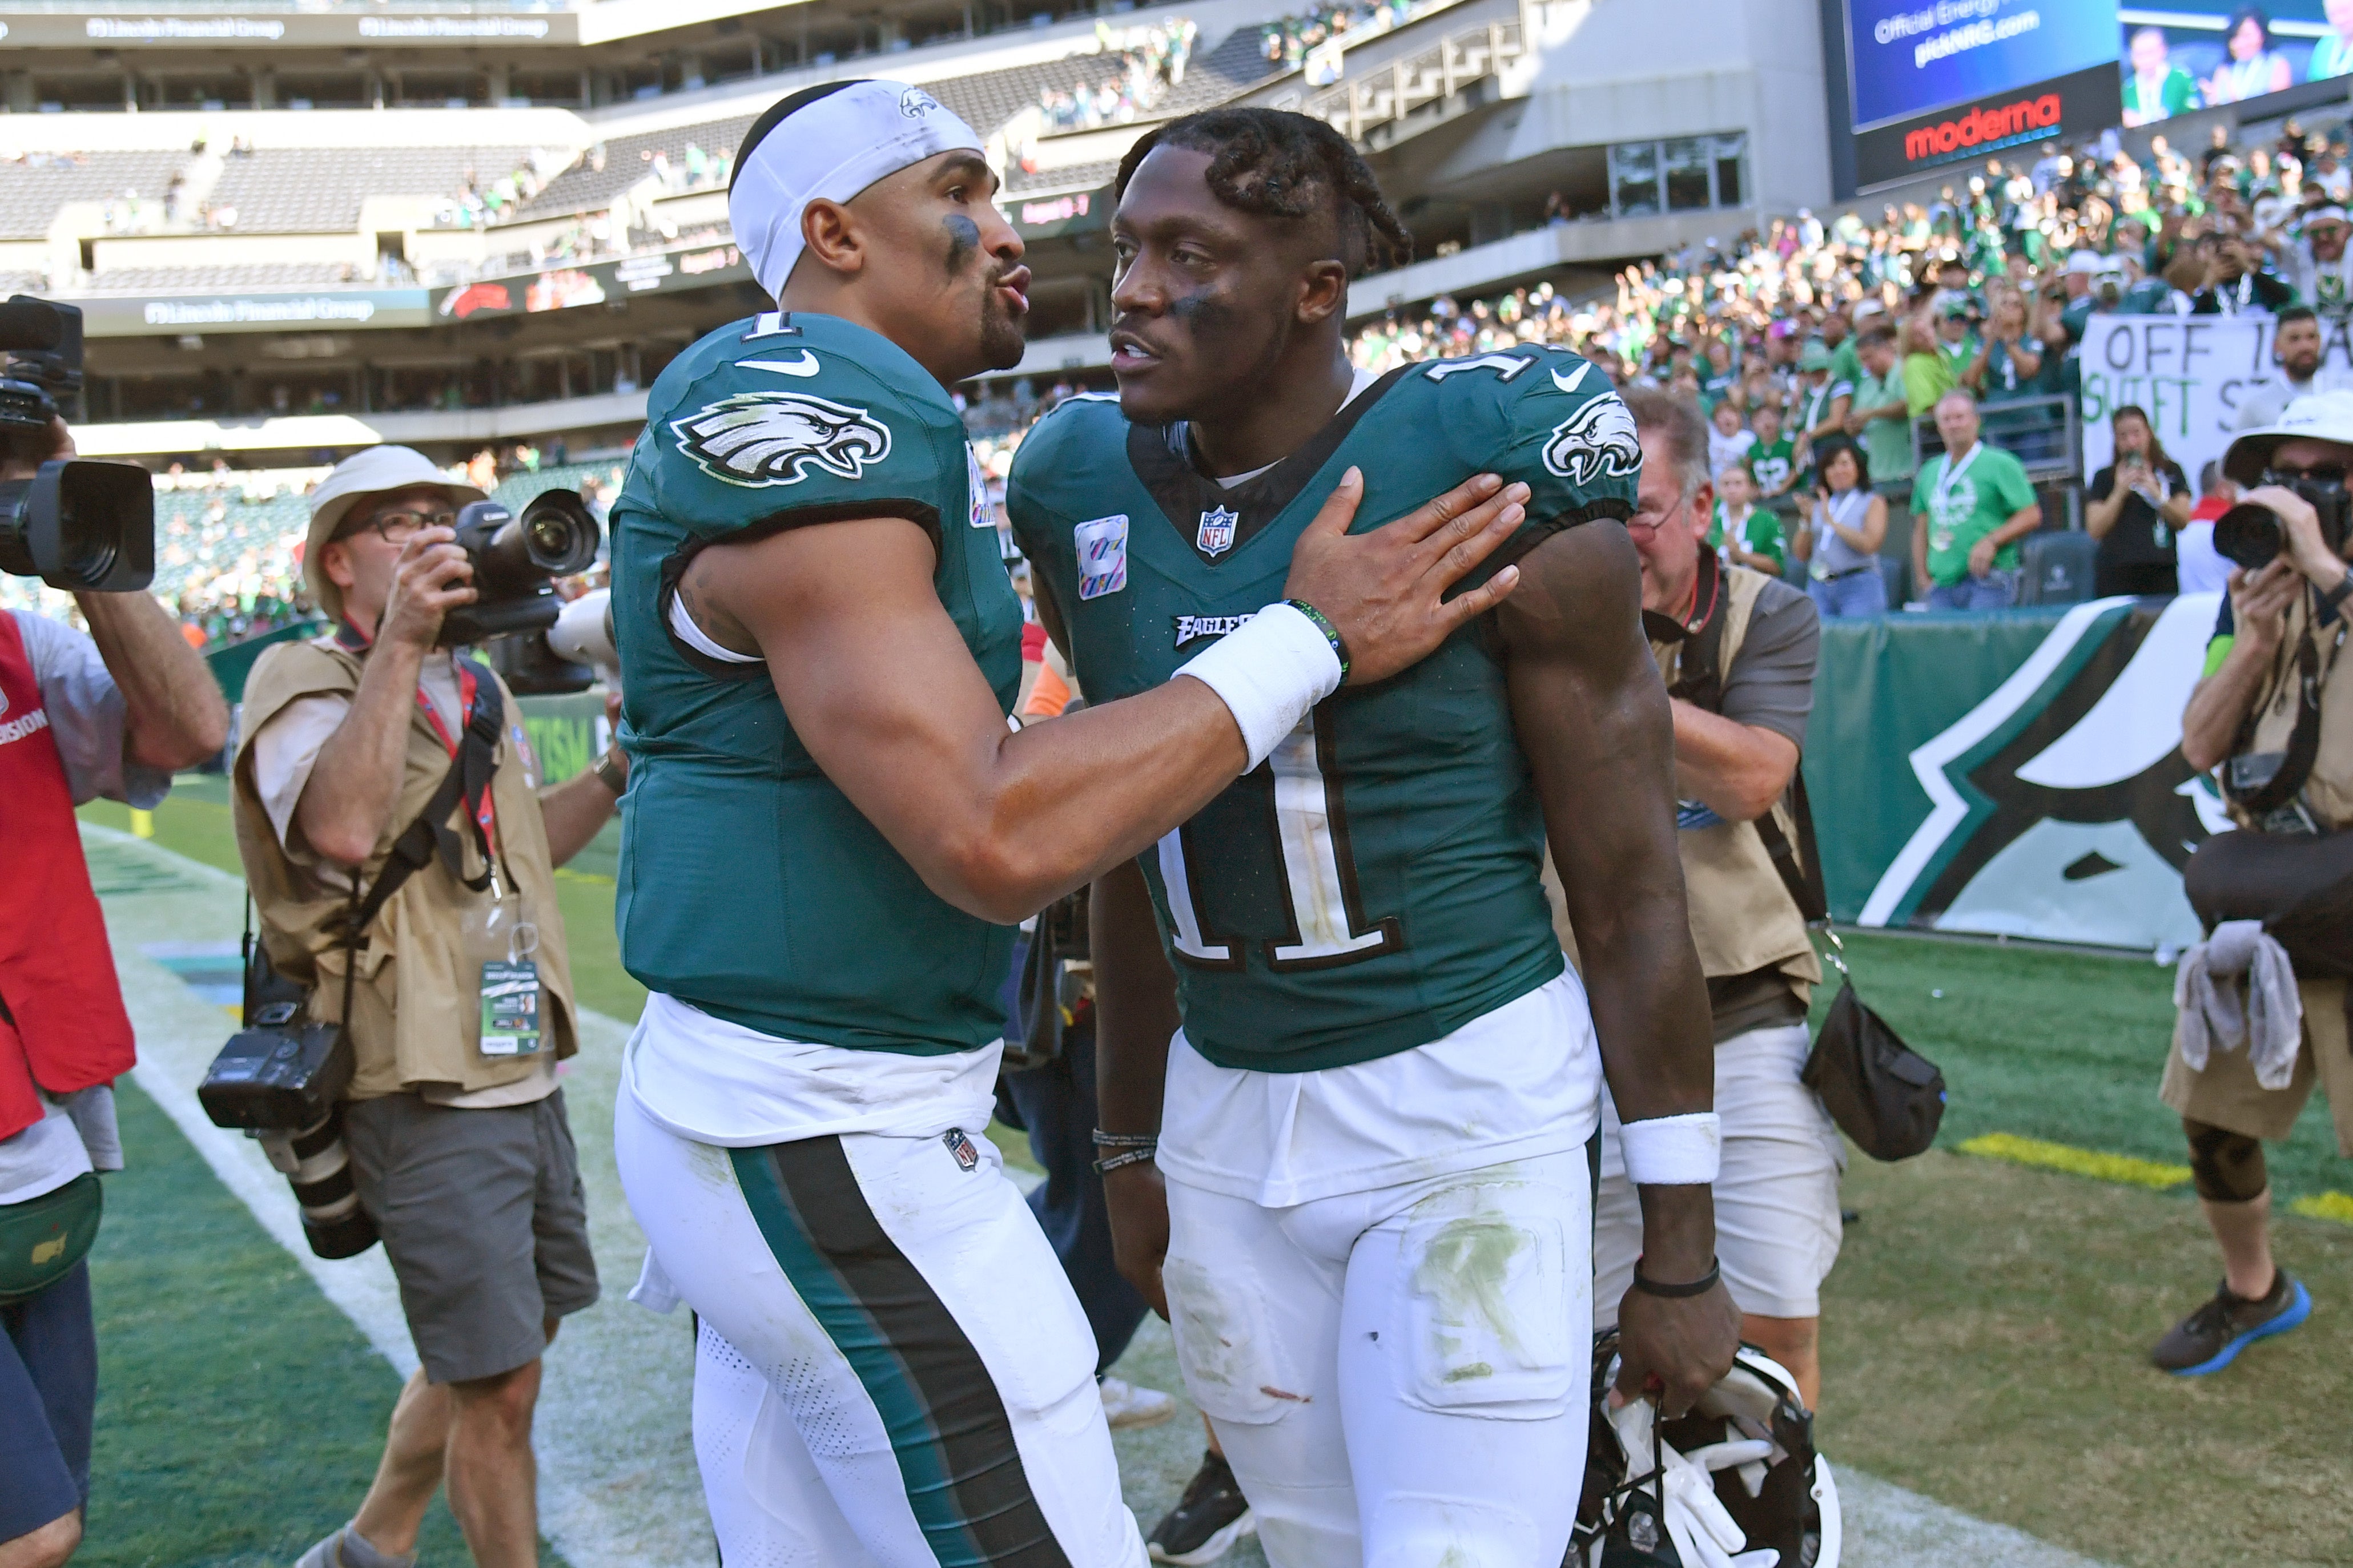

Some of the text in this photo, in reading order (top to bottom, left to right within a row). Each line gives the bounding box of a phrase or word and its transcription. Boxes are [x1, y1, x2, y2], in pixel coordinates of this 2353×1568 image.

[1875, 5, 1937, 44] Official
[1905, 93, 2062, 161] moderna
[2105, 324, 2212, 372] OFF
[1202, 529, 1227, 547] NFL
